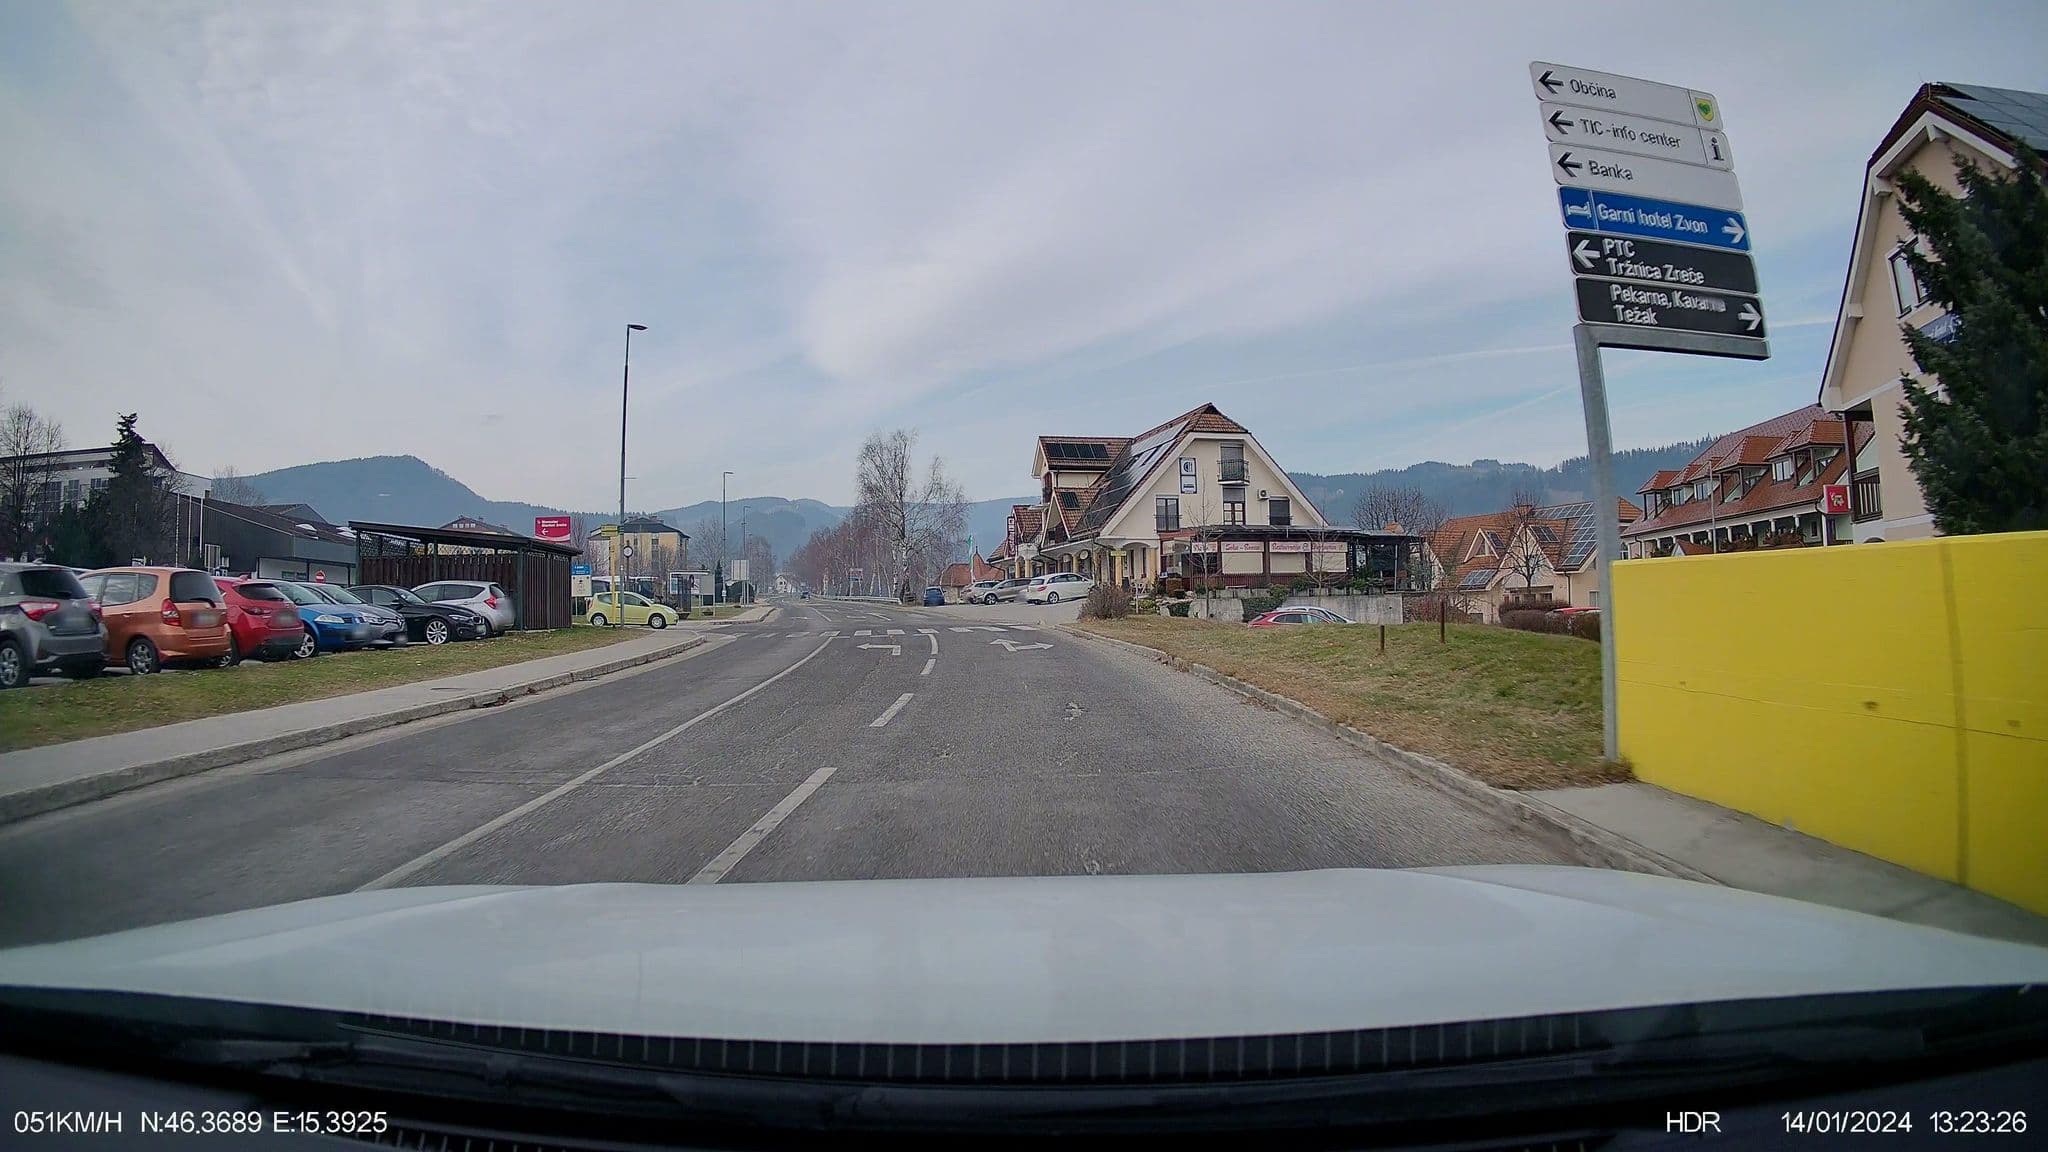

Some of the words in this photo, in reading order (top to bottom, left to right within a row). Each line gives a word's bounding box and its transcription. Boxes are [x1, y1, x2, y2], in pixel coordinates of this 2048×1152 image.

[1570, 79, 1617, 99] Občina
[1640, 131, 1681, 148] center
[1588, 160, 1634, 181] Banka
[1597, 203, 1635, 224] Garni
[1638, 208, 1673, 229] hotel
[1673, 214, 1708, 234] Zvon
[1602, 238, 1636, 258] PTC
[1606, 257, 1662, 280] Tržnica
[1662, 263, 1705, 285] Zreče
[1609, 284, 1672, 309] Pekarna,
[1613, 304, 1659, 326] Težak
